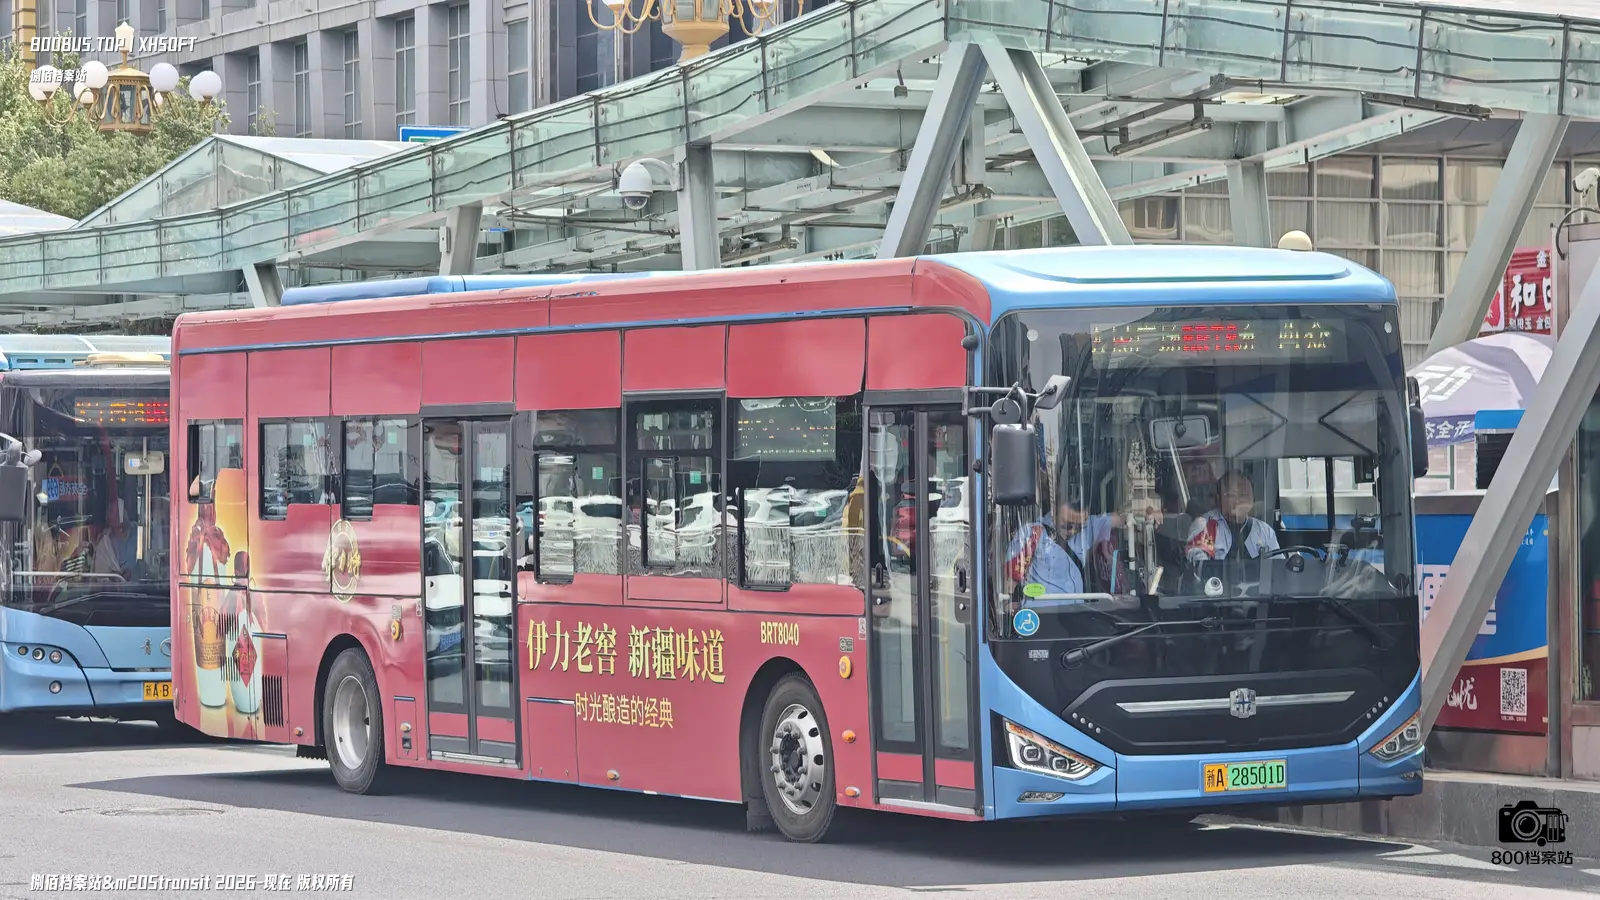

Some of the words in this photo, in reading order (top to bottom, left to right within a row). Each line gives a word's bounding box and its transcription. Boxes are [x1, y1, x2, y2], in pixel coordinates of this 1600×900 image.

[1536, 249, 1551, 269] 金
[760, 620, 800, 647] BRT8040
[526, 618, 618, 676] 伊力老窖
[628, 624, 727, 684] 新疆味道
[575, 691, 674, 729] 时光酿造的经典
[1231, 765, 1284, 786] 28501D
